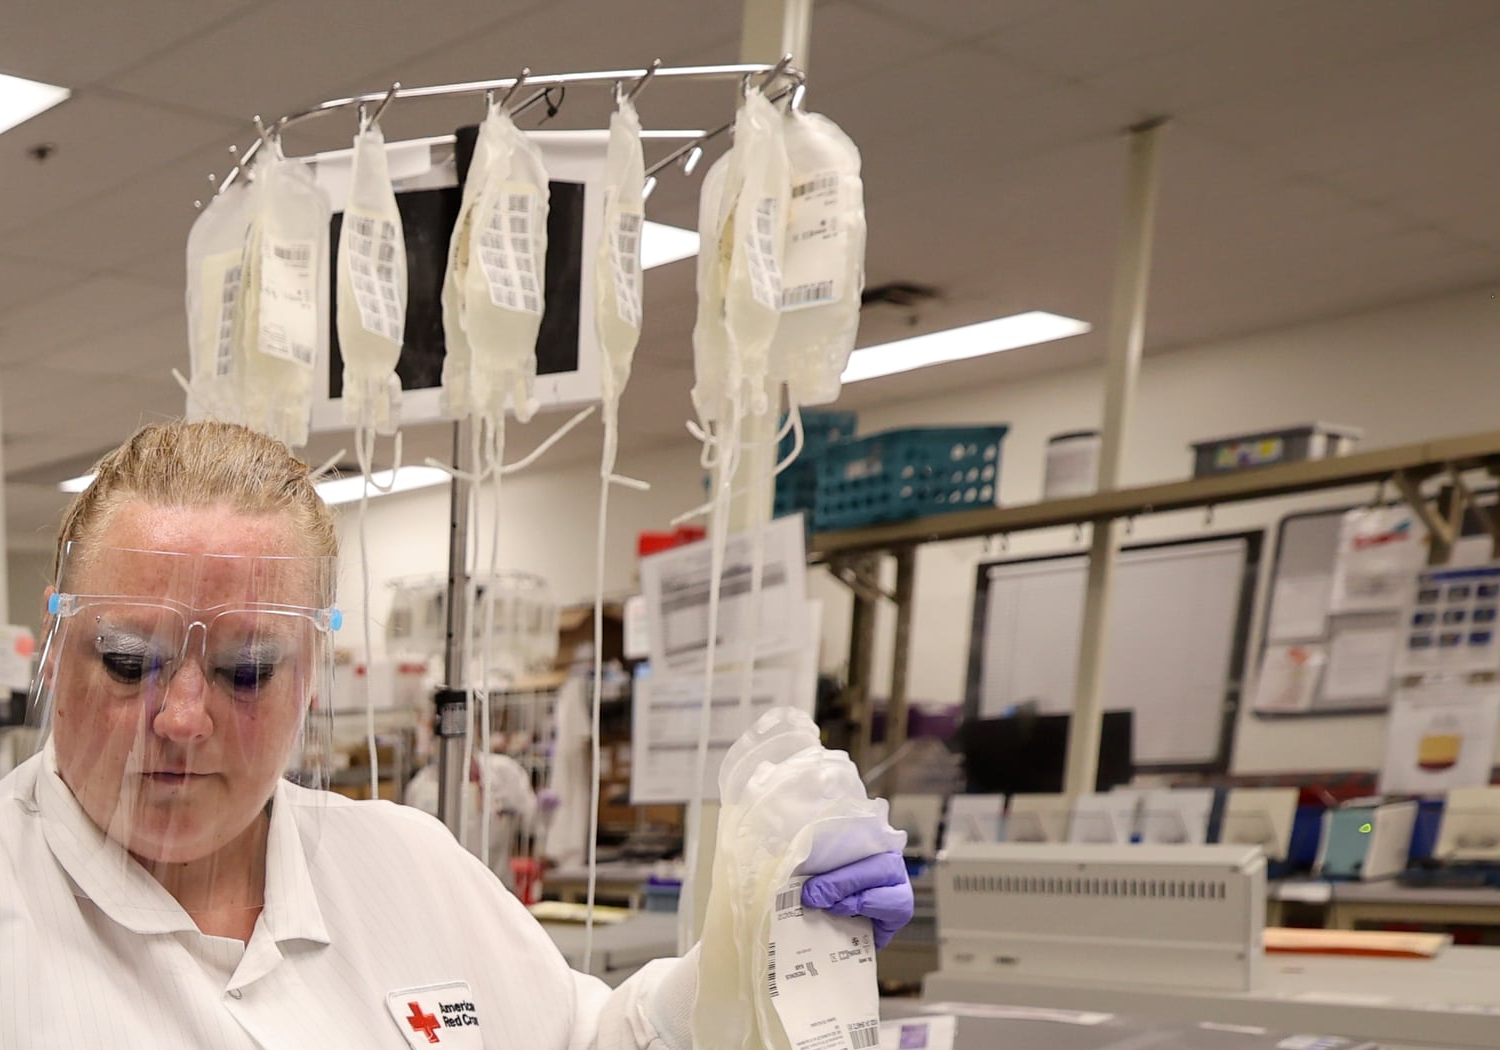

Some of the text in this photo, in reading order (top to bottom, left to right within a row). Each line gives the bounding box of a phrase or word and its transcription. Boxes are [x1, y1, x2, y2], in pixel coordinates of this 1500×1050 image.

[438, 1000, 477, 1014] America
[442, 1013, 480, 1028] Red Cro
